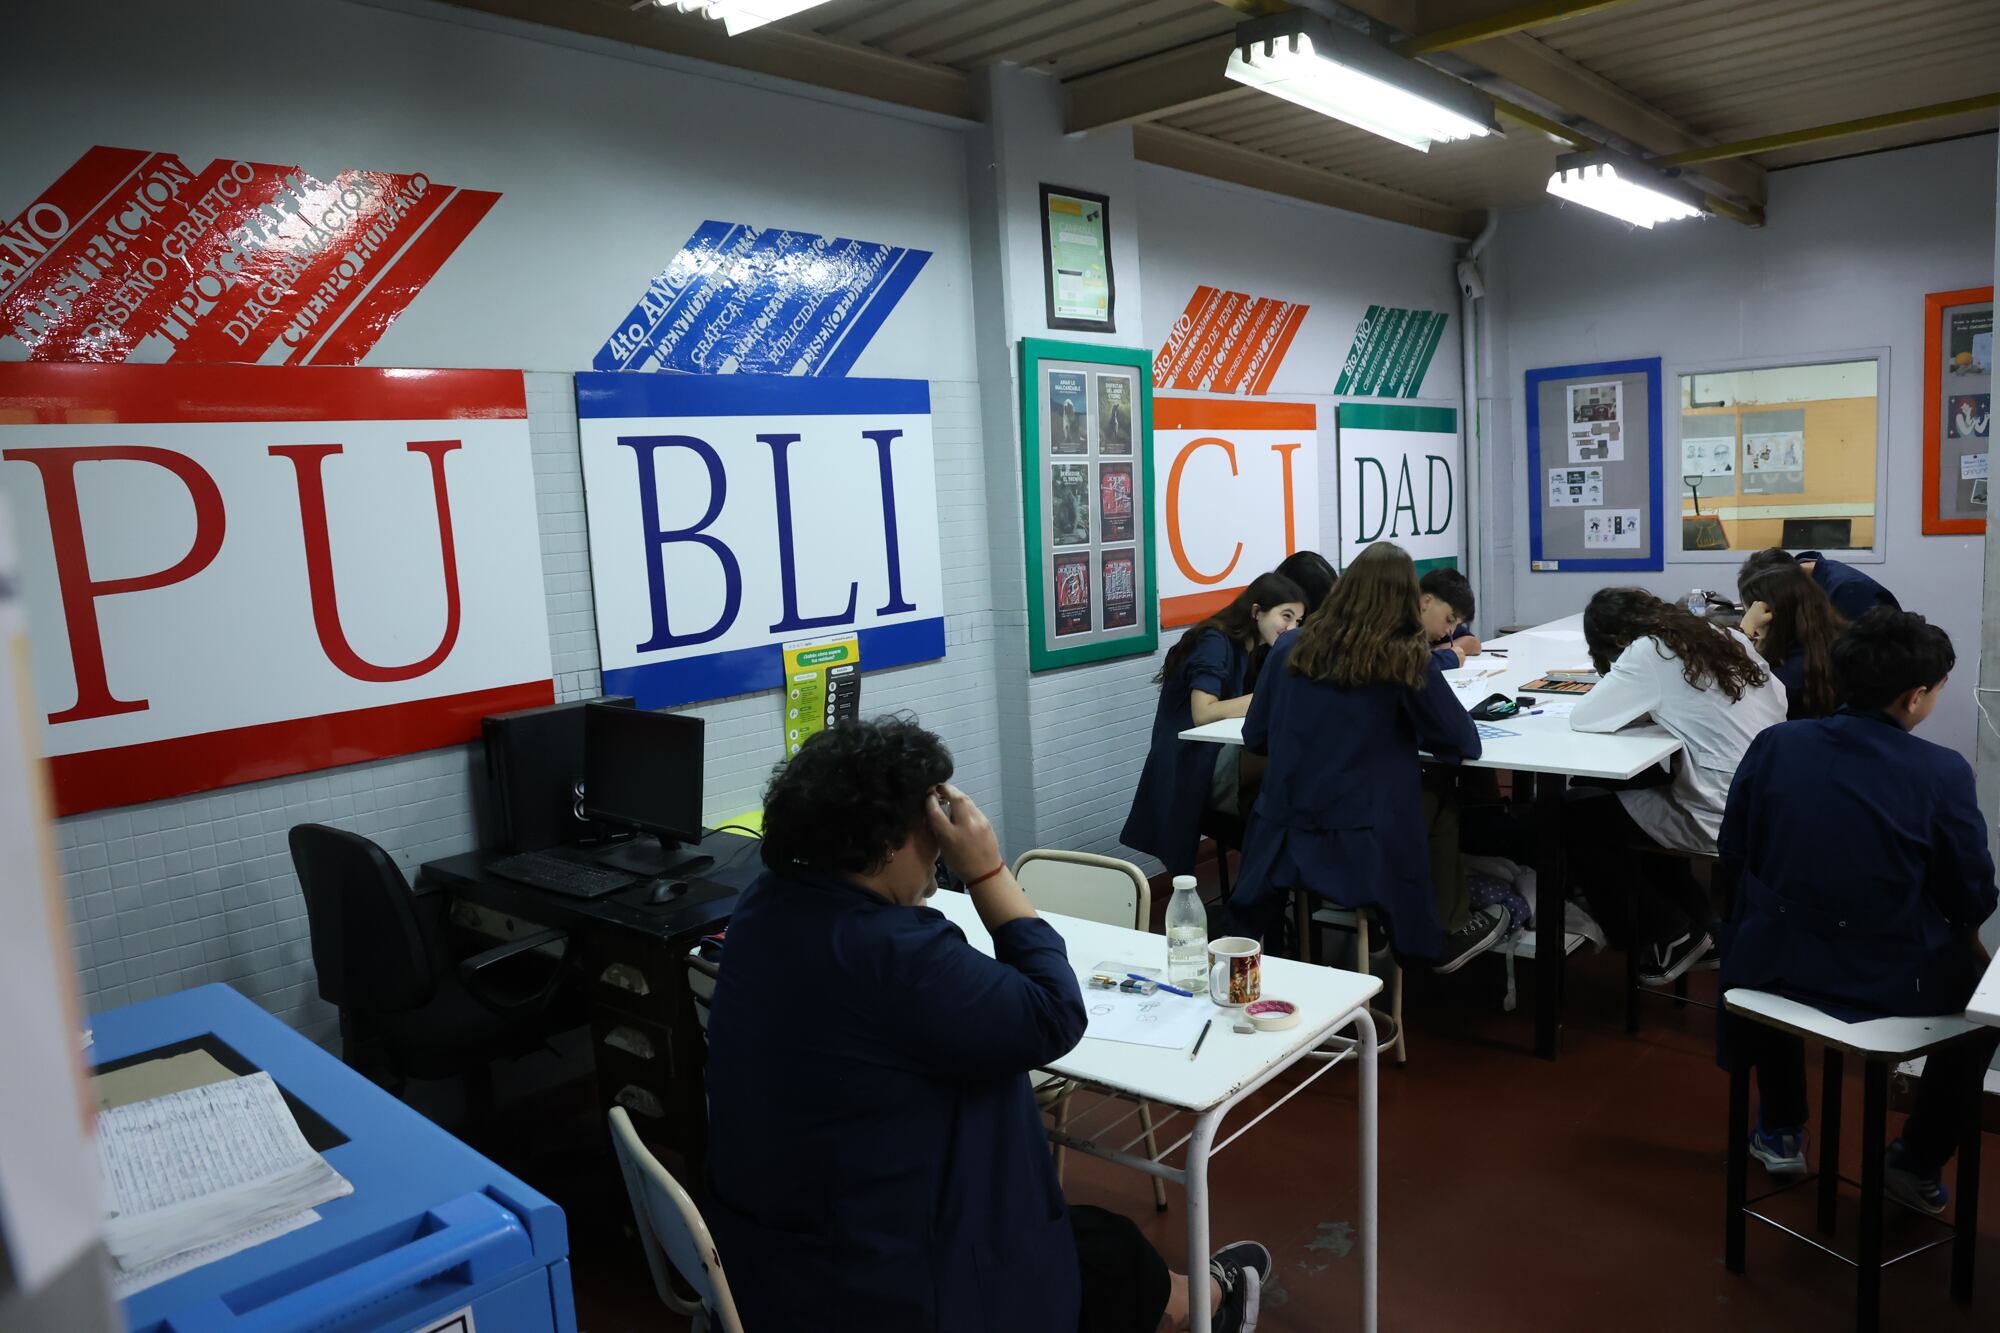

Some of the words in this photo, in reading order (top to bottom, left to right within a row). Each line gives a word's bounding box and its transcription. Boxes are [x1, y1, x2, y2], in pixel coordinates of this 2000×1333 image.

[11, 156, 194, 352] ILUSTRACIÓN
[82, 258, 168, 346] DISEÑO
[162, 161, 255, 259] GRÁFICO
[146, 168, 321, 351] TIPOGRAFÍA
[222, 173, 380, 346] DIAGRAMACIÓN
[281, 258, 359, 348] CUERPO
[354, 172, 431, 261] HUMANO
[608, 323, 645, 362] 4to
[691, 299, 741, 364] GRÁFICA
[768, 293, 826, 366] PUBLICIDAD
[803, 307, 843, 366] DISEÑO
[1152, 355, 1170, 382] 5to
[1167, 313, 1191, 355] AÑO
[1187, 342, 1211, 383] PUNTO
[1208, 325, 1221, 347] DE
[1217, 293, 1240, 328] VENTA
[1207, 297, 1256, 382] PACKAGING
[1224, 354, 1243, 387] AFICHES
[1344, 353, 1358, 377] 6to
[1354, 318, 1371, 356] AÑO
[617, 428, 917, 654] BLI
[1165, 437, 1302, 585] CI
[1354, 453, 1453, 544] DAD
[2, 440, 462, 725] PU
